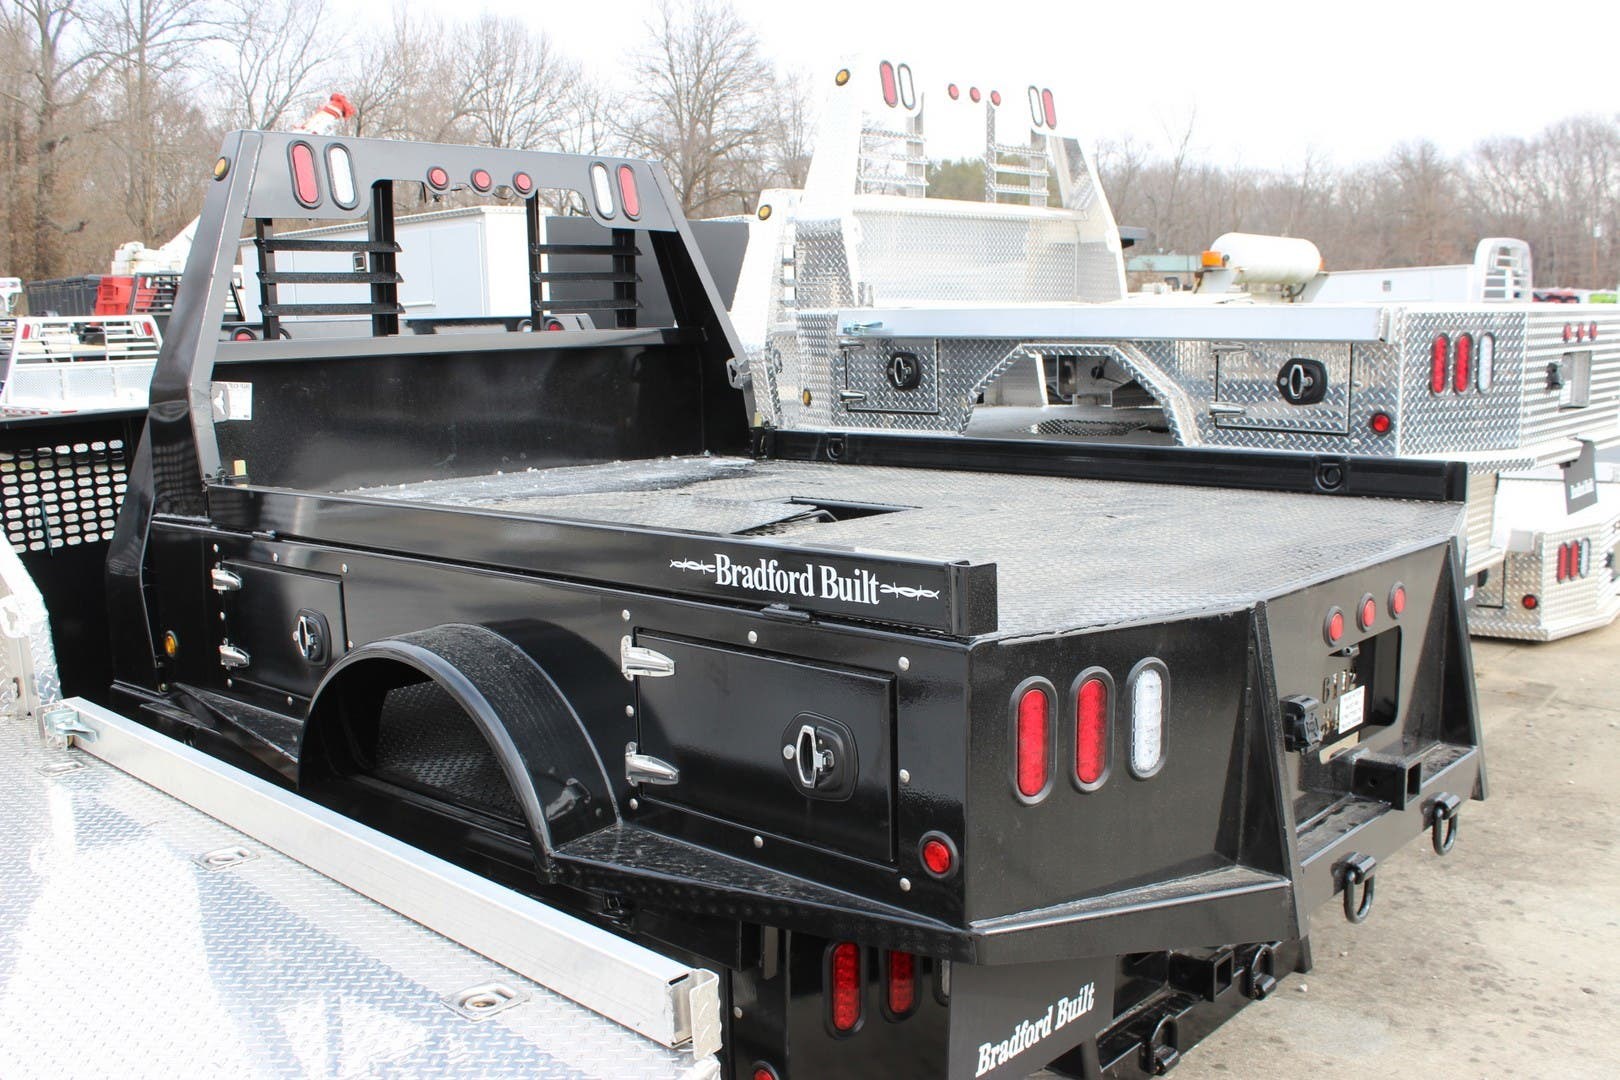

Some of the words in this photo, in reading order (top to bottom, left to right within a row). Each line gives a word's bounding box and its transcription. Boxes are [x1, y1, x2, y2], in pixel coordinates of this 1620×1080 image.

[714, 553, 815, 597] Bradford
[818, 565, 880, 605] Built
[975, 1005, 1054, 1078] Bradford
[1054, 981, 1095, 1031] Built
